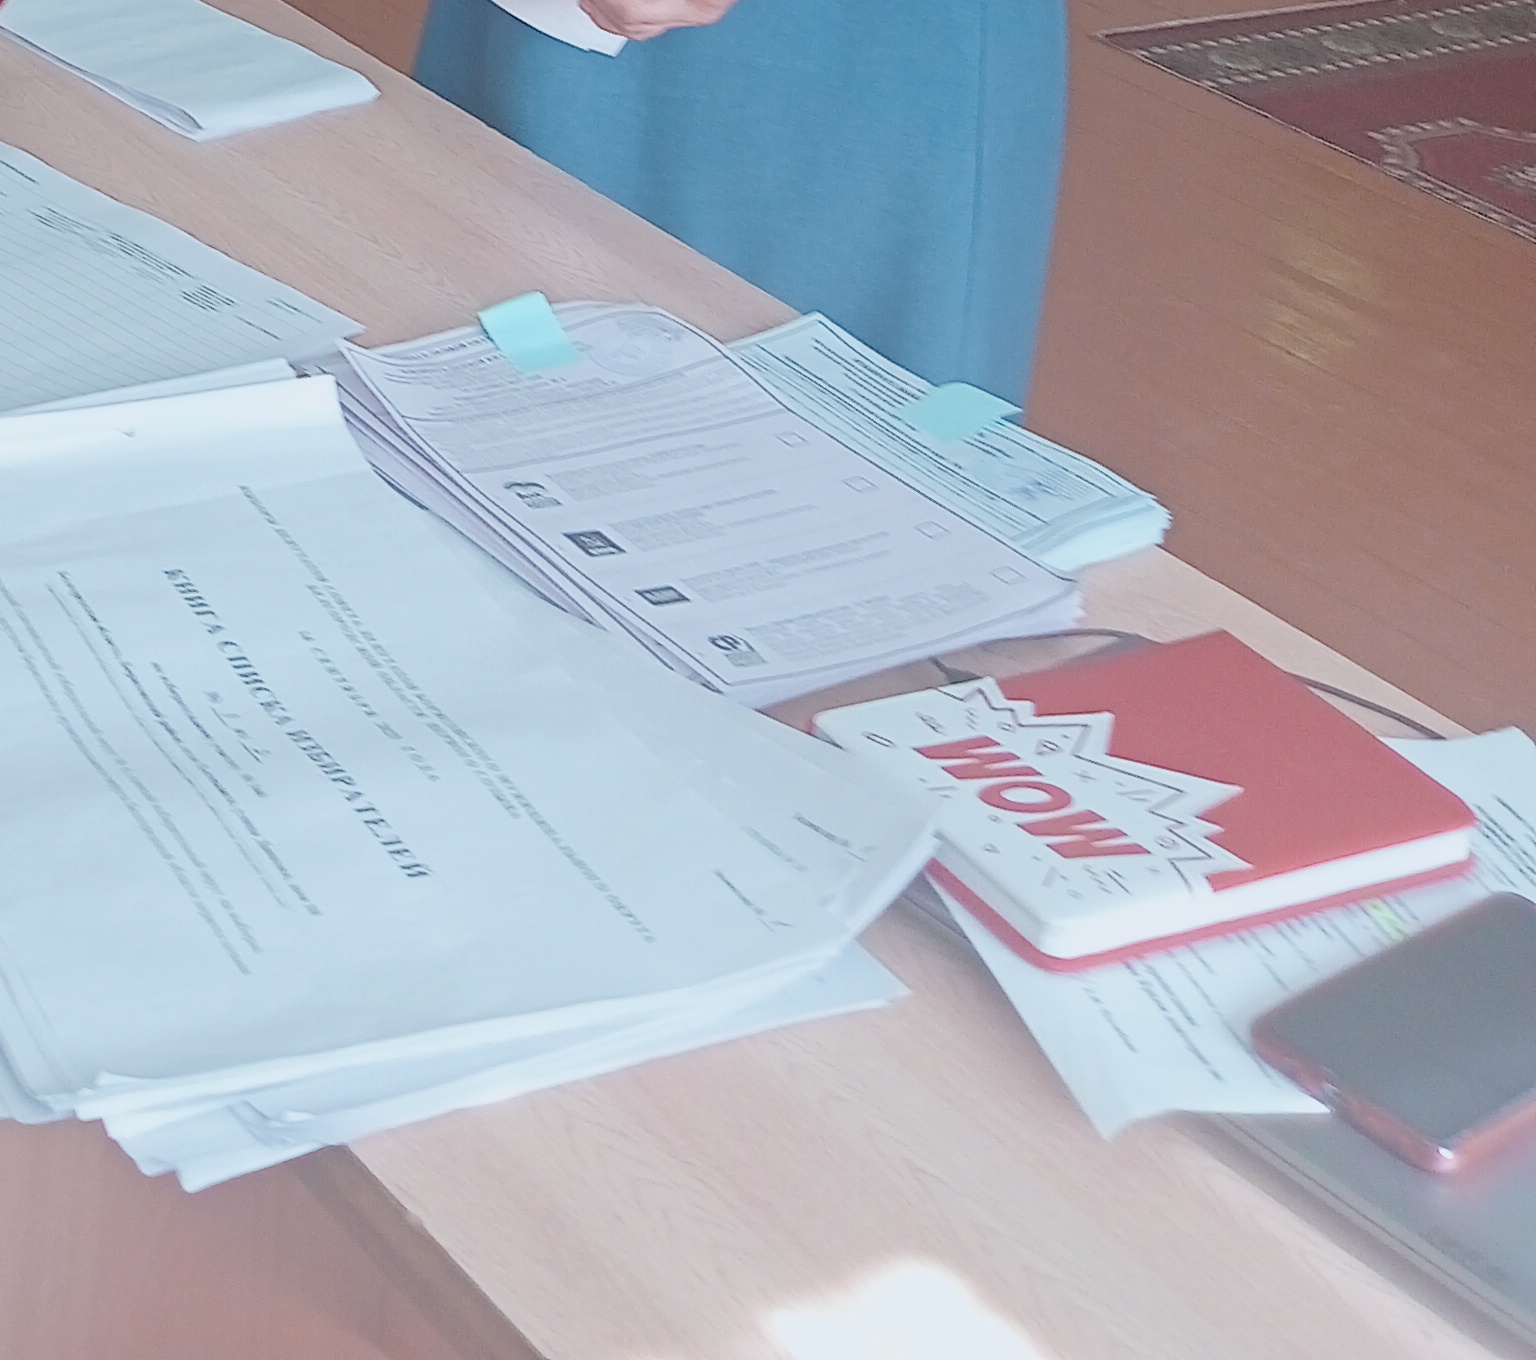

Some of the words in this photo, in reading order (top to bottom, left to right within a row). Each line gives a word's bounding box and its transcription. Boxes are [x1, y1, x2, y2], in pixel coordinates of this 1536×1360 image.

[162, 568, 226, 635] КНИГА
[217, 640, 296, 726] СПИСКА
[284, 728, 434, 878] ИЗБИРАТЕЛЕЙ
[913, 735, 1151, 859] WOW
